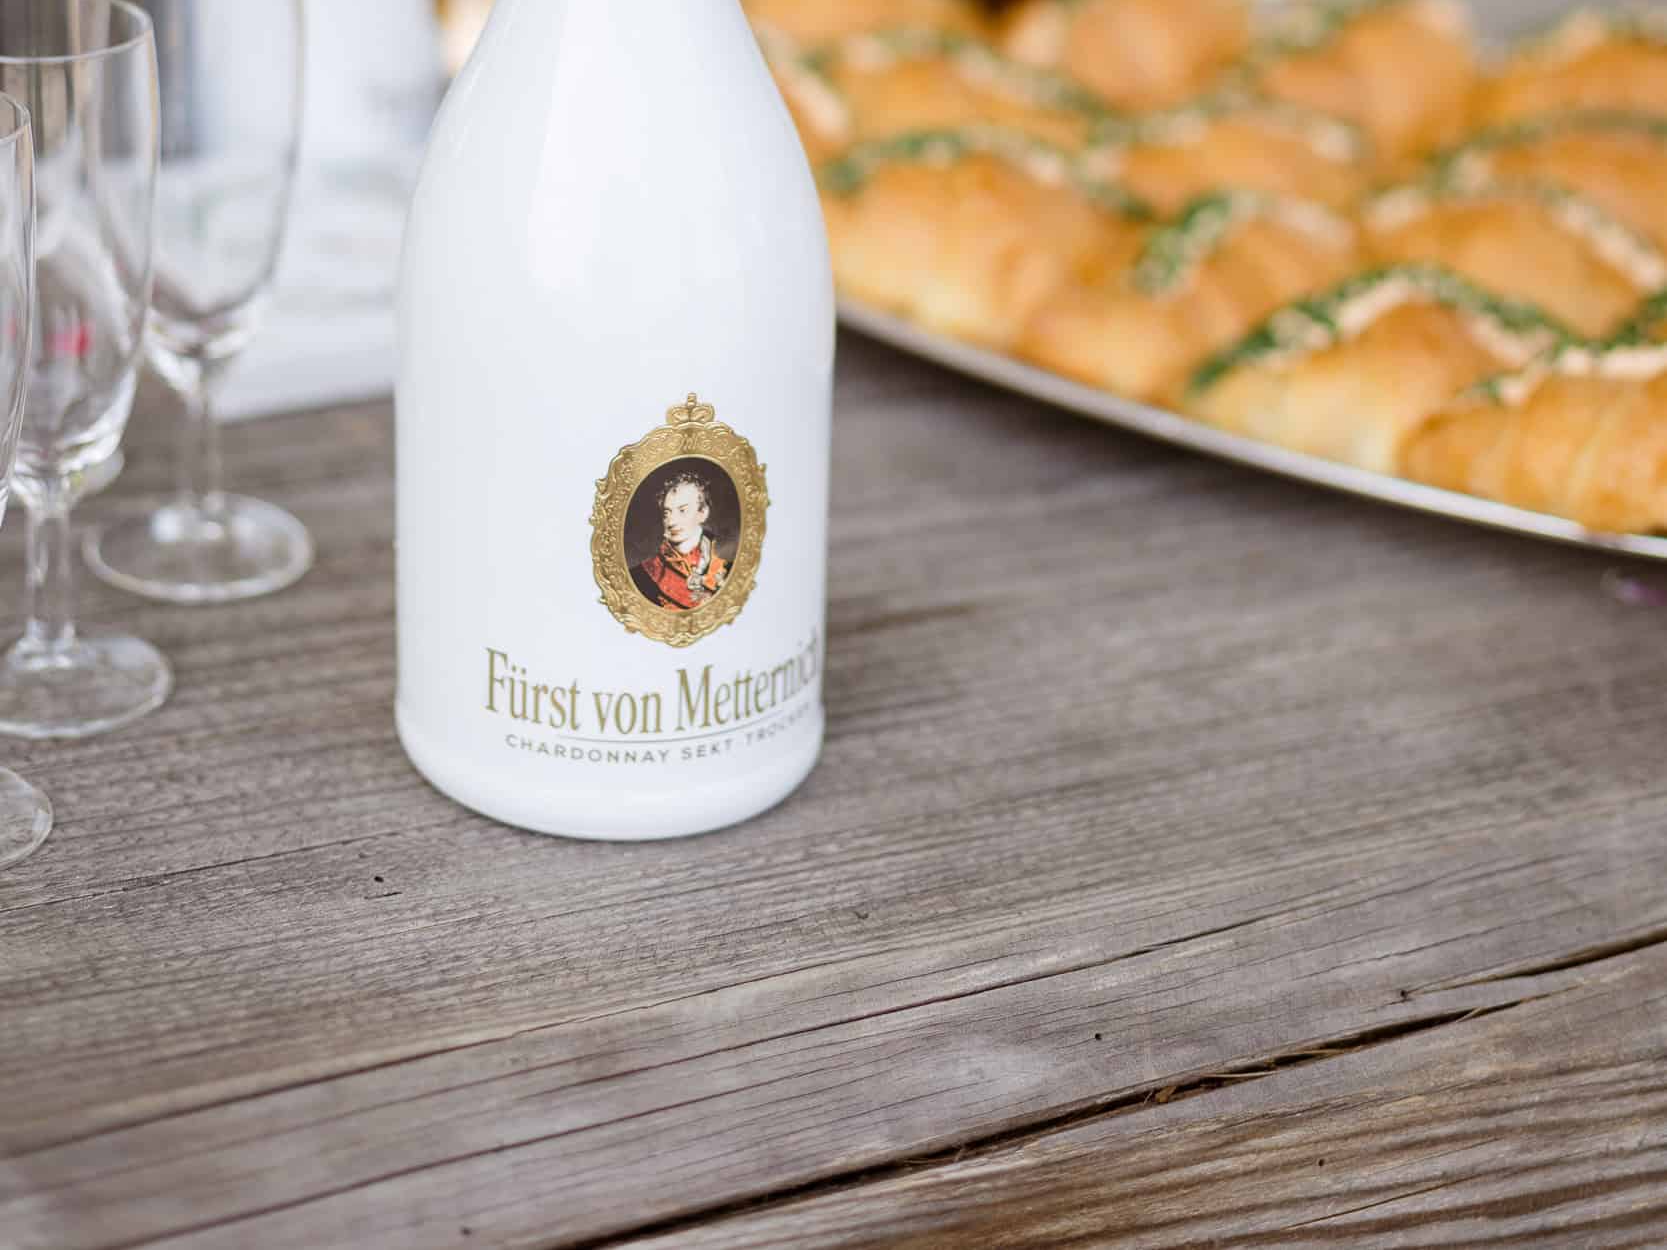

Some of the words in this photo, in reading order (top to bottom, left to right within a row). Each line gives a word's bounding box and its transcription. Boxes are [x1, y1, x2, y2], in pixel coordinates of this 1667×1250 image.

[485, 647, 581, 731] Fürst
[592, 691, 663, 735] von
[505, 733, 670, 764] CHARDONNAY
[681, 738, 733, 760] SEKT
